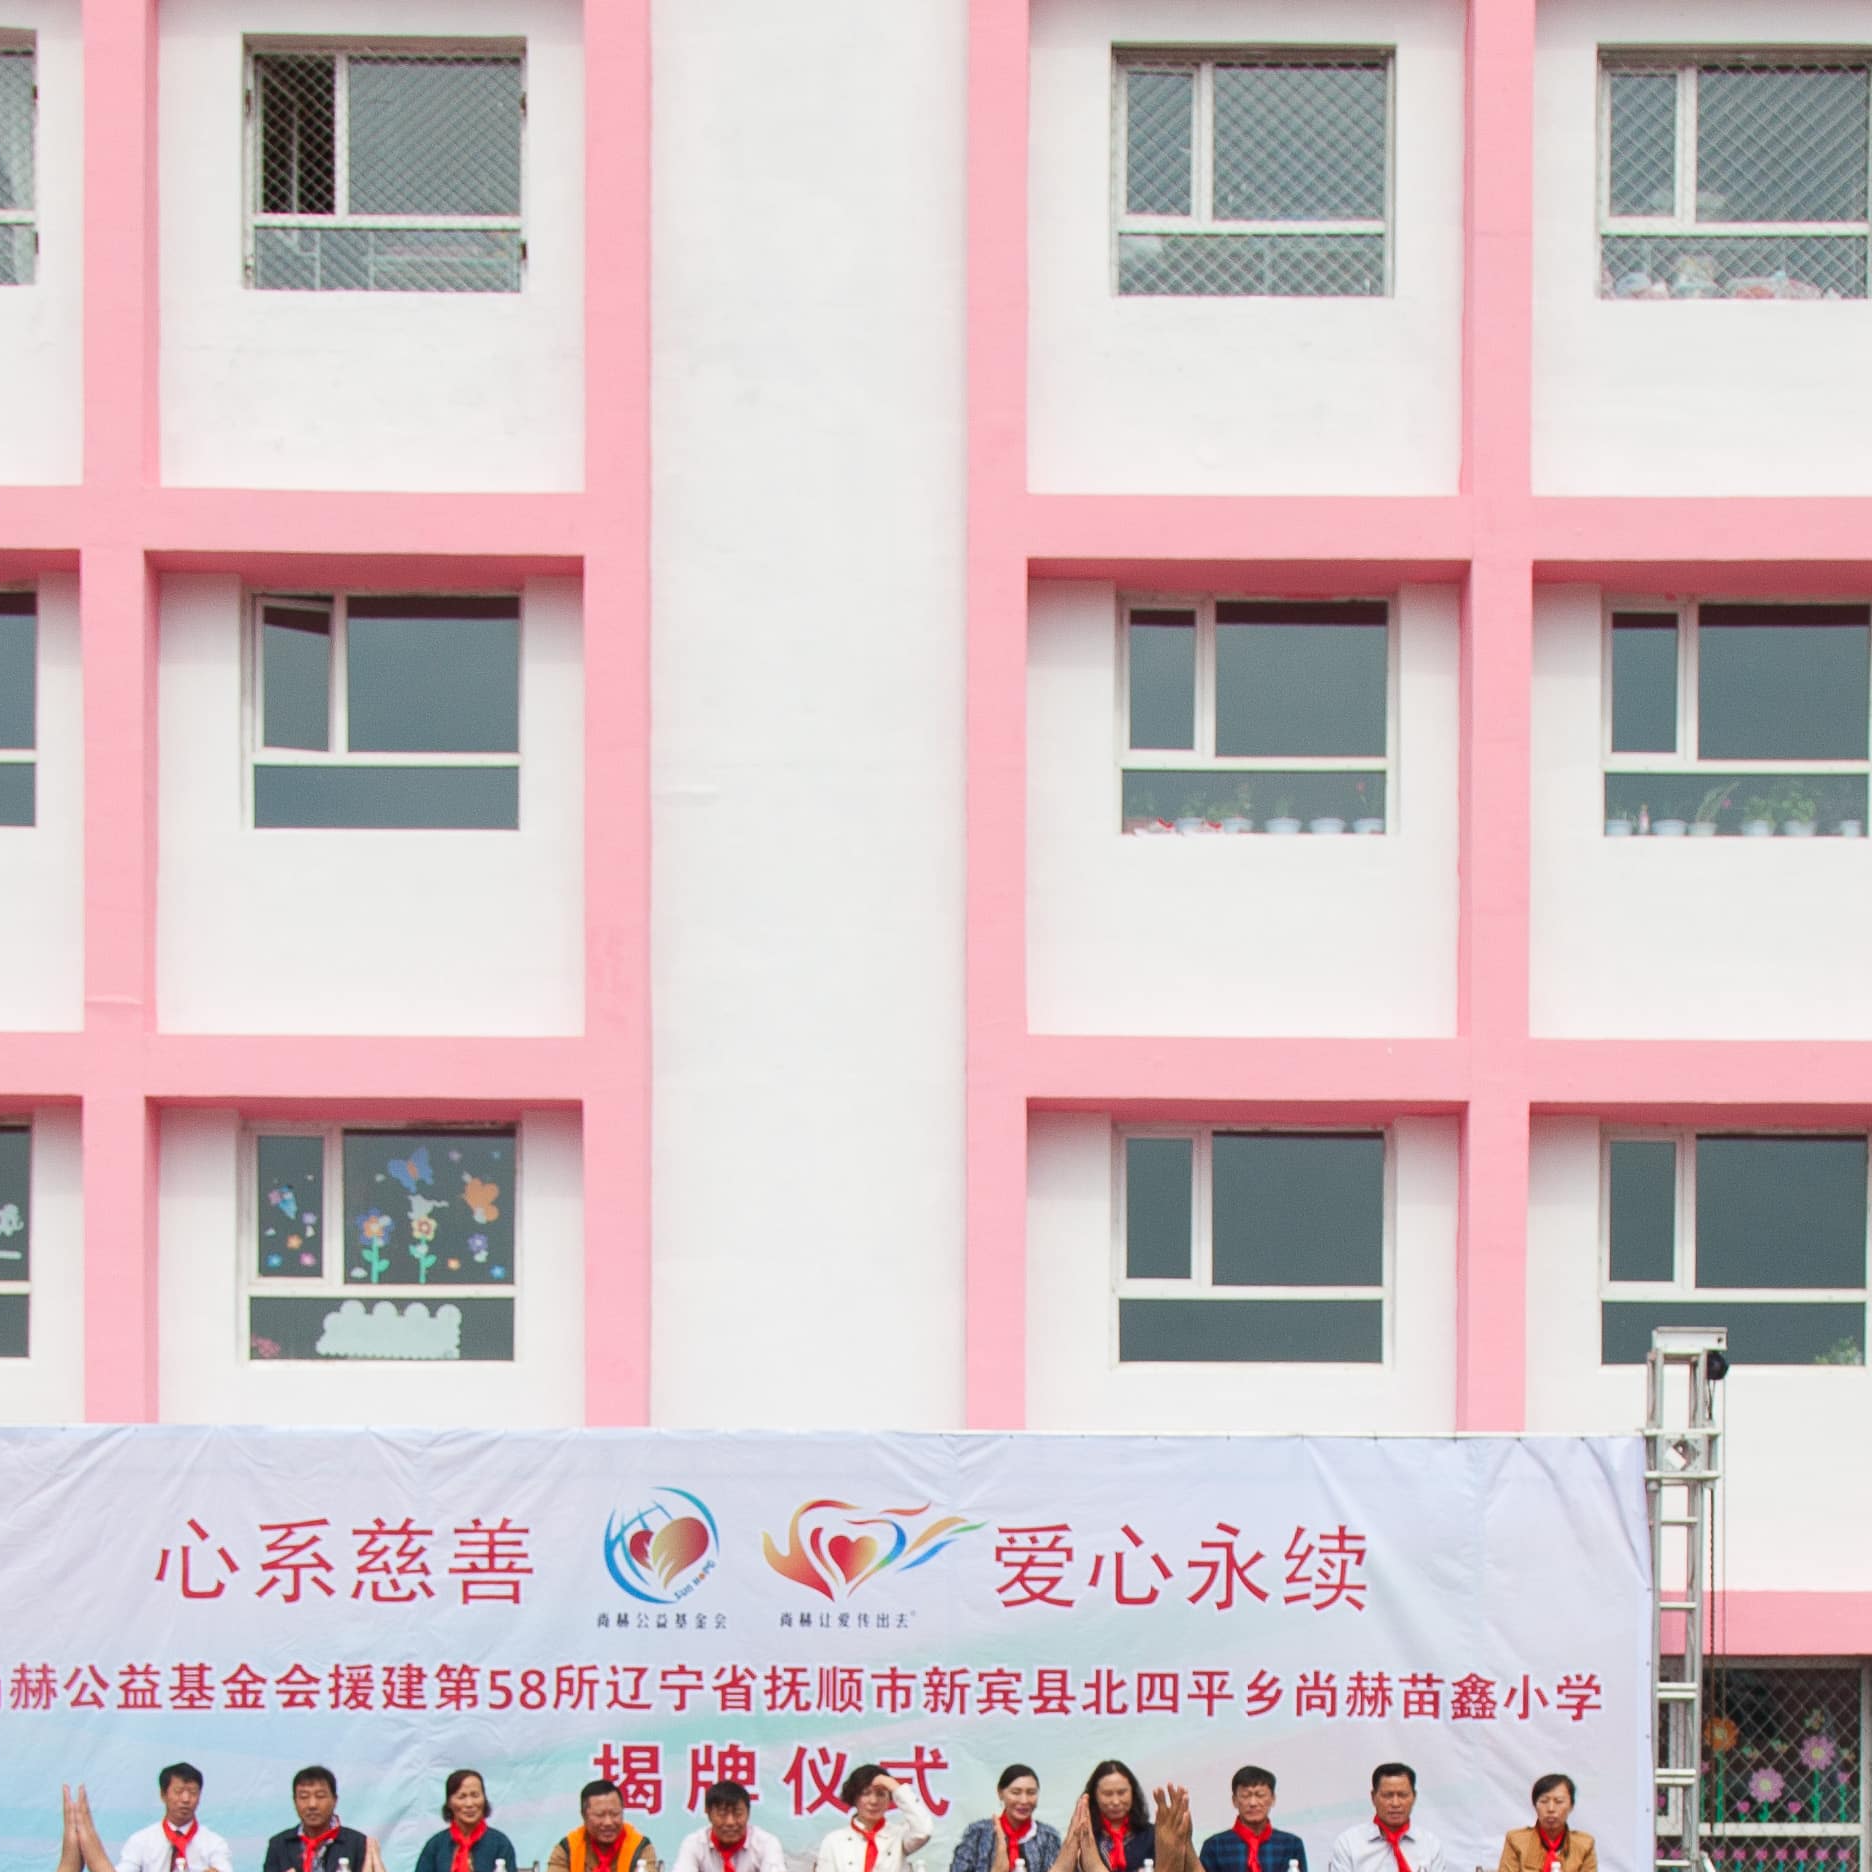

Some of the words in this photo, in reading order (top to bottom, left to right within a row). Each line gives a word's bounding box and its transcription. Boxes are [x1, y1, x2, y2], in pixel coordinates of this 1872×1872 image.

[154, 1517, 535, 1606] 心系慈善
[993, 1521, 1368, 1612] 爱心永续
[596, 1611, 728, 1629] 尚赫公益基金会
[779, 1611, 910, 1629] 尚赫让爱传出去
[592, 1742, 951, 1818] 揭牌仪式
